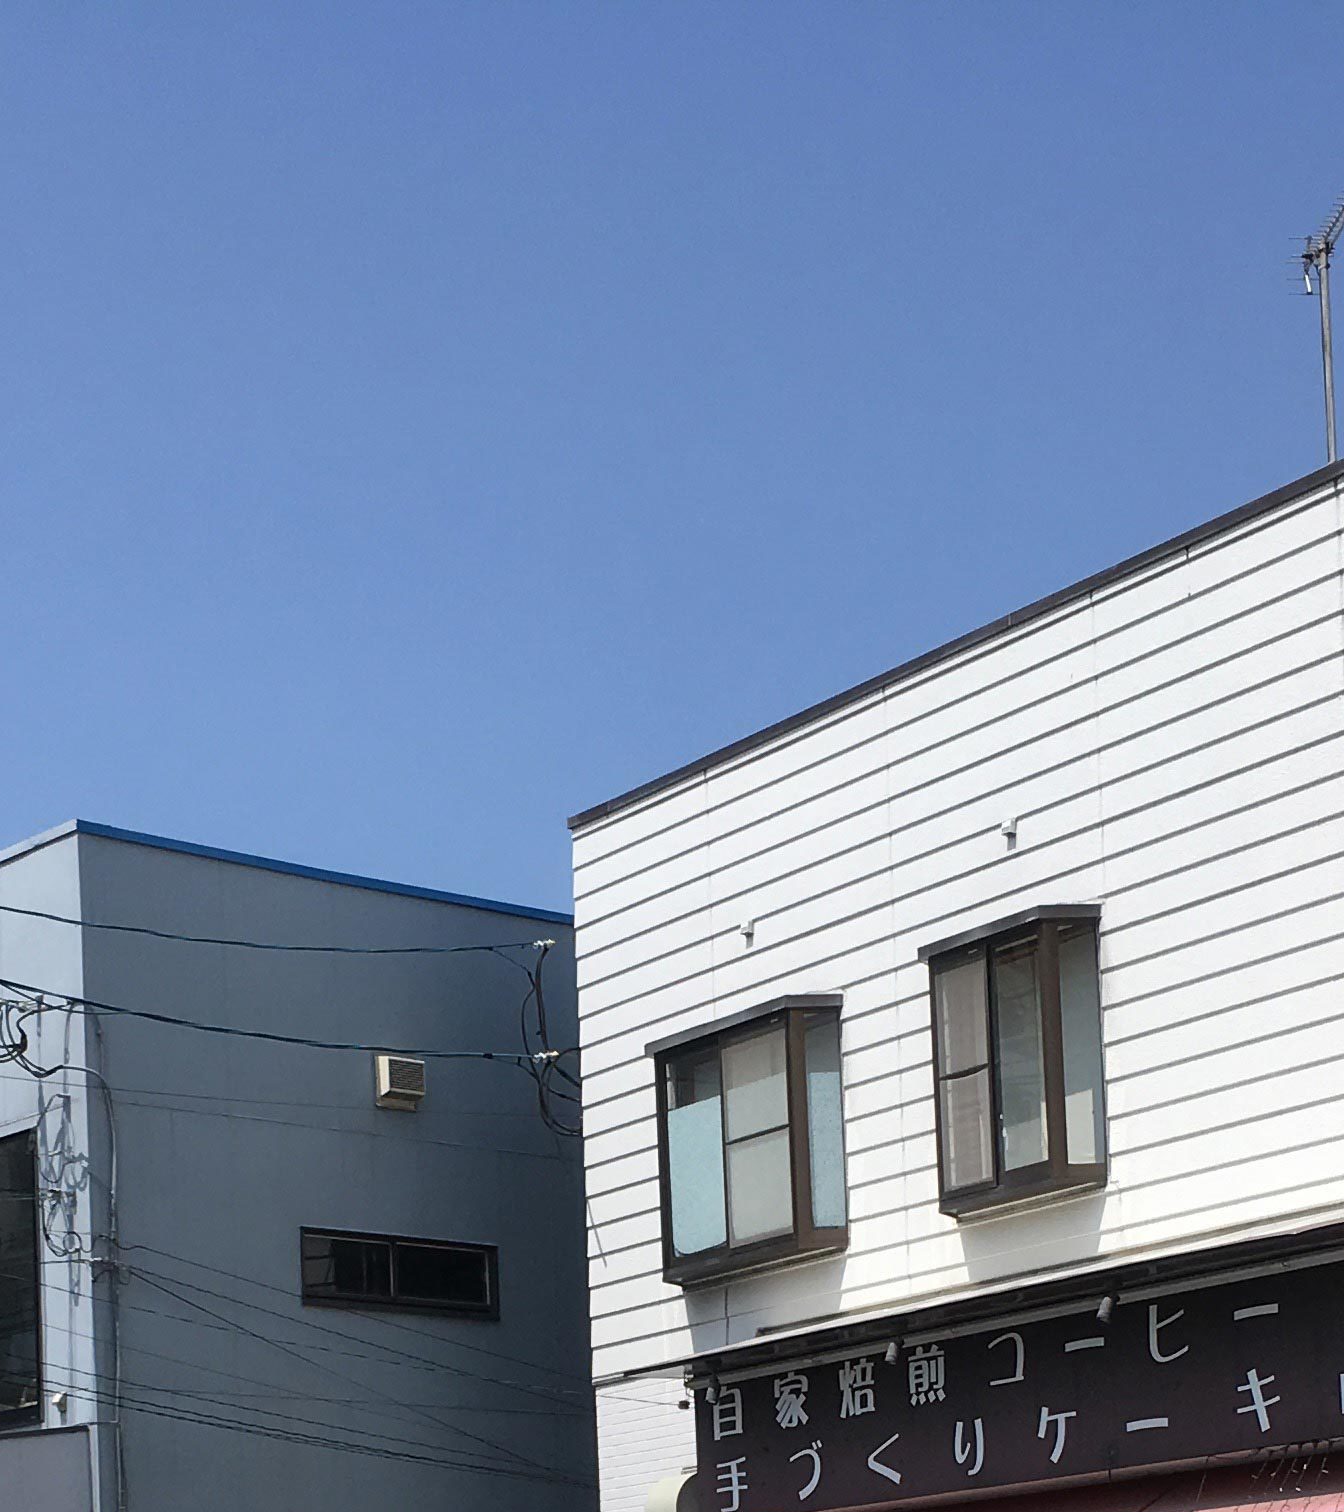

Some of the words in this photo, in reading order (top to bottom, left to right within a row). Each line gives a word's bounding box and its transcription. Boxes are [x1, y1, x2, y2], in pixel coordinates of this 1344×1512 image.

[712, 1303, 1279, 1441] 自家焙煎コーヒー
[716, 1369, 1280, 1512] 手づくりケーキ
